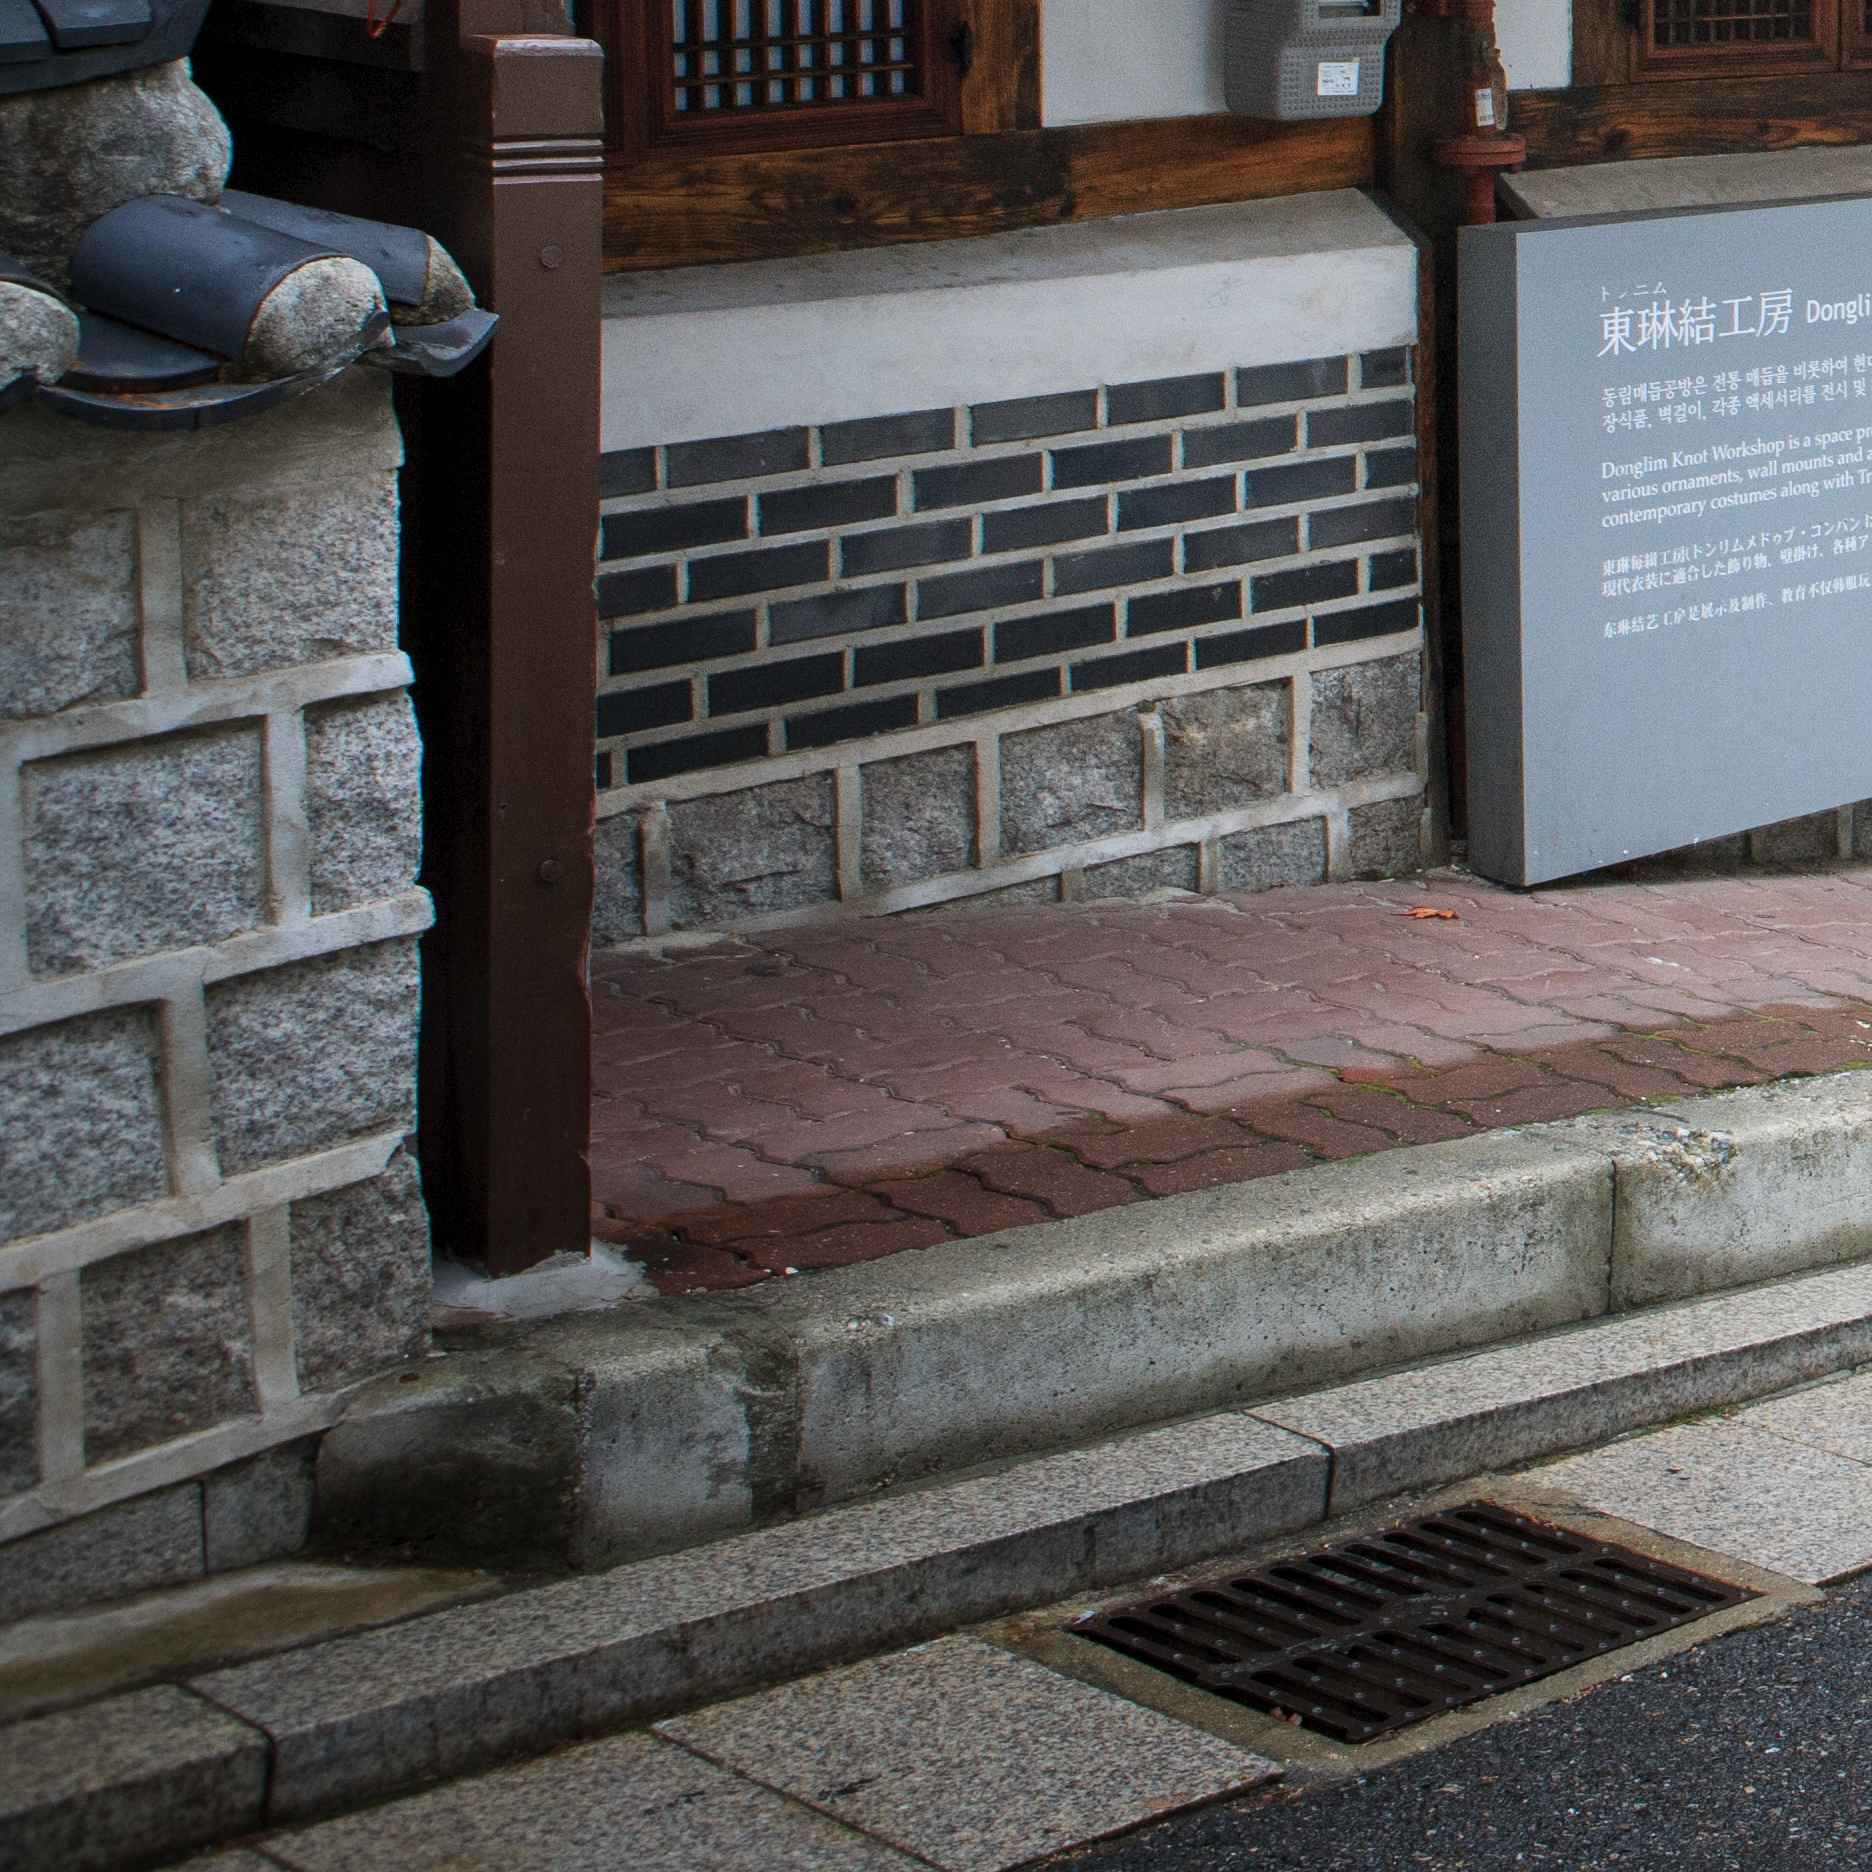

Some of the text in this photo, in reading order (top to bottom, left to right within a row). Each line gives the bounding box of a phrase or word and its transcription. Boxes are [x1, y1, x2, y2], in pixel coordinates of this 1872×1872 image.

[1597, 288, 1793, 358] 東琳結工房
[1602, 375, 1709, 408] 동림매듭공방은
[1713, 370, 1742, 392] 전통
[1745, 364, 1789, 387] 매듭을
[1793, 355, 1848, 379] 비롯하여
[1712, 395, 1741, 416] 각종
[1745, 384, 1817, 411] 액세서리를
[1821, 380, 1848, 401] 전시
[1854, 377, 1867, 397] 및
[1602, 455, 1668, 479] Donglim
[1672, 448, 1708, 468] Knot
[1712, 437, 1785, 462] Workshop
[1787, 434, 1800, 450] is
[1803, 436, 1812, 448] a
[1815, 428, 1852, 450] space
[1602, 482, 1658, 503] various
[1662, 470, 1743, 494] ornaments,
[1748, 460, 1777, 479] wall
[1781, 454, 1834, 474] mounts
[1837, 447, 1863, 466] and
[1602, 498, 1706, 529] contemporary
[1710, 487, 1777, 510] costumes
[1780, 478, 1819, 499] along
[1823, 470, 1854, 490] with
